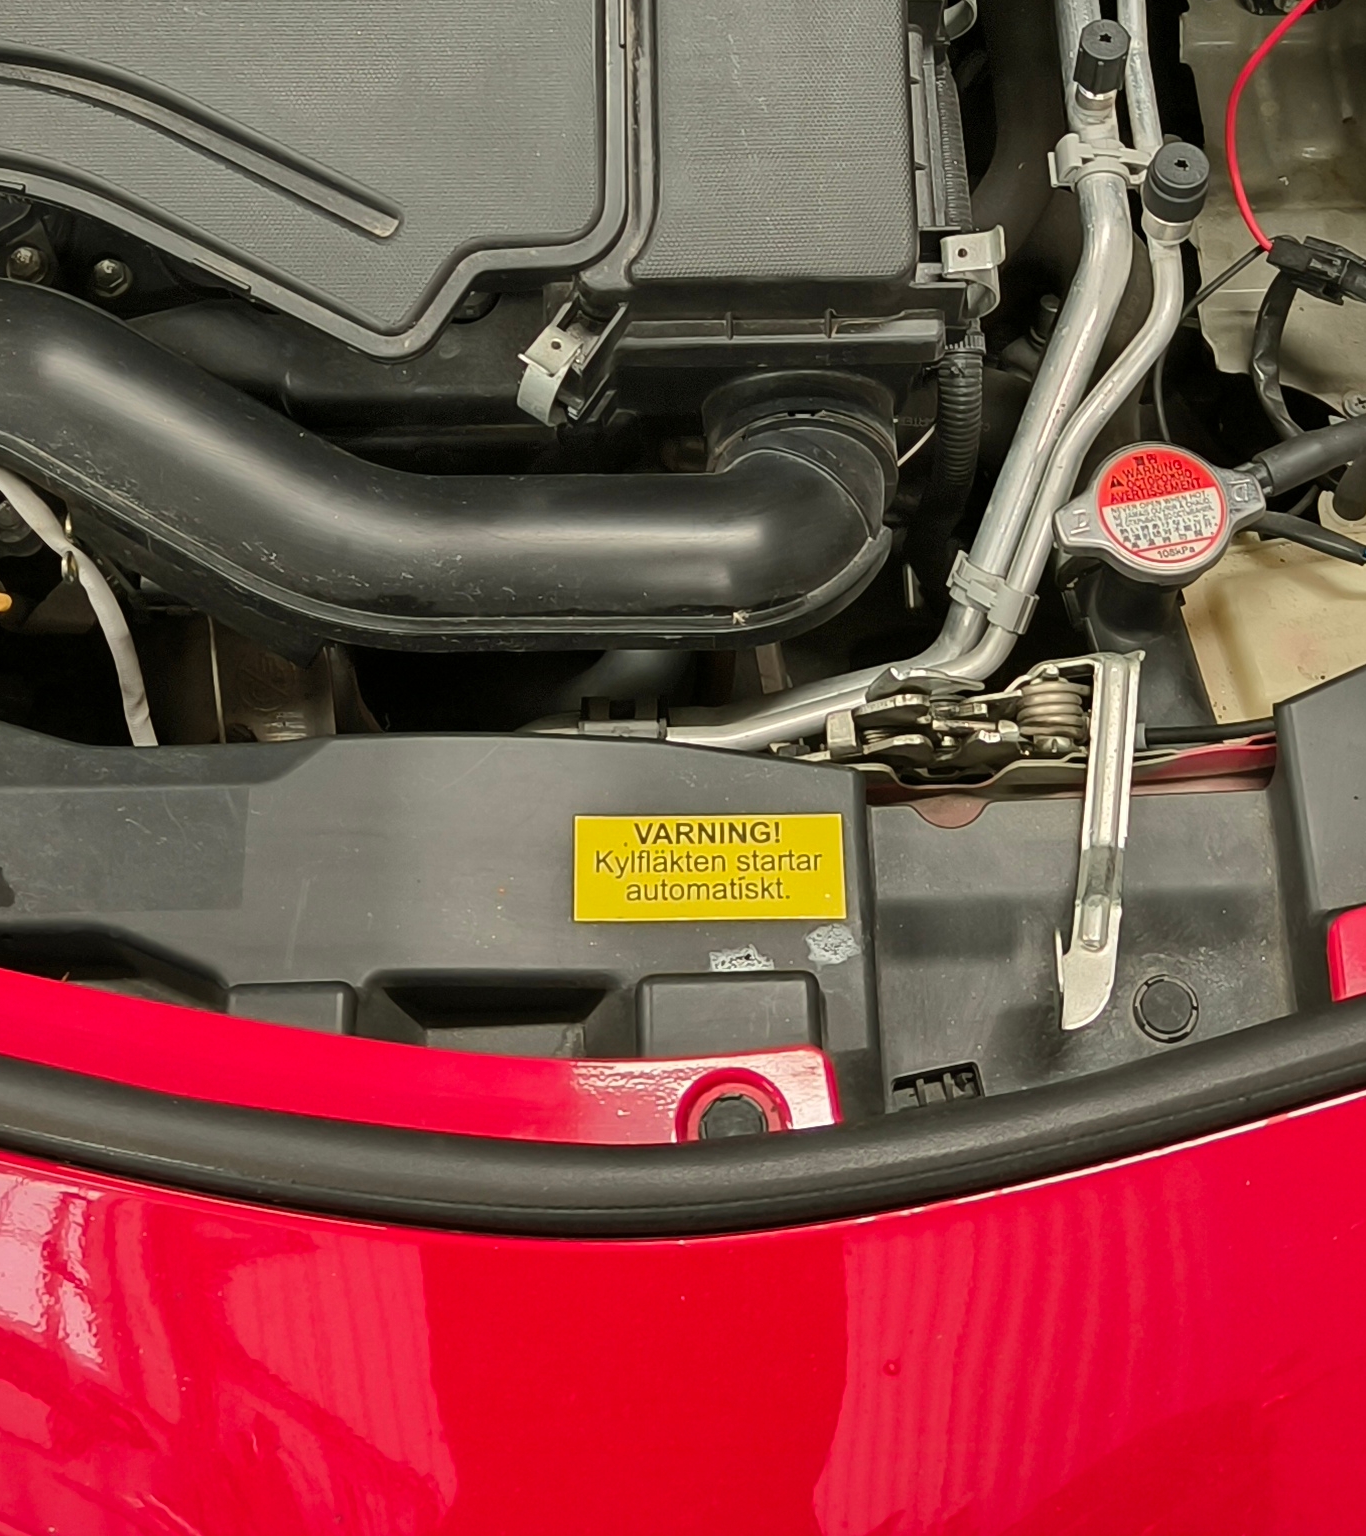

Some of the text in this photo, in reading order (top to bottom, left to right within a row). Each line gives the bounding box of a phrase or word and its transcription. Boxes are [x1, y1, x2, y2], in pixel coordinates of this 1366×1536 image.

[1122, 459, 1183, 479] WARNING
[1110, 477, 1203, 504] AVERTISSEMENT
[634, 821, 783, 846] VARNING!
[595, 848, 823, 879] Kylfläkten startar
[625, 876, 792, 902] automatiskt.
